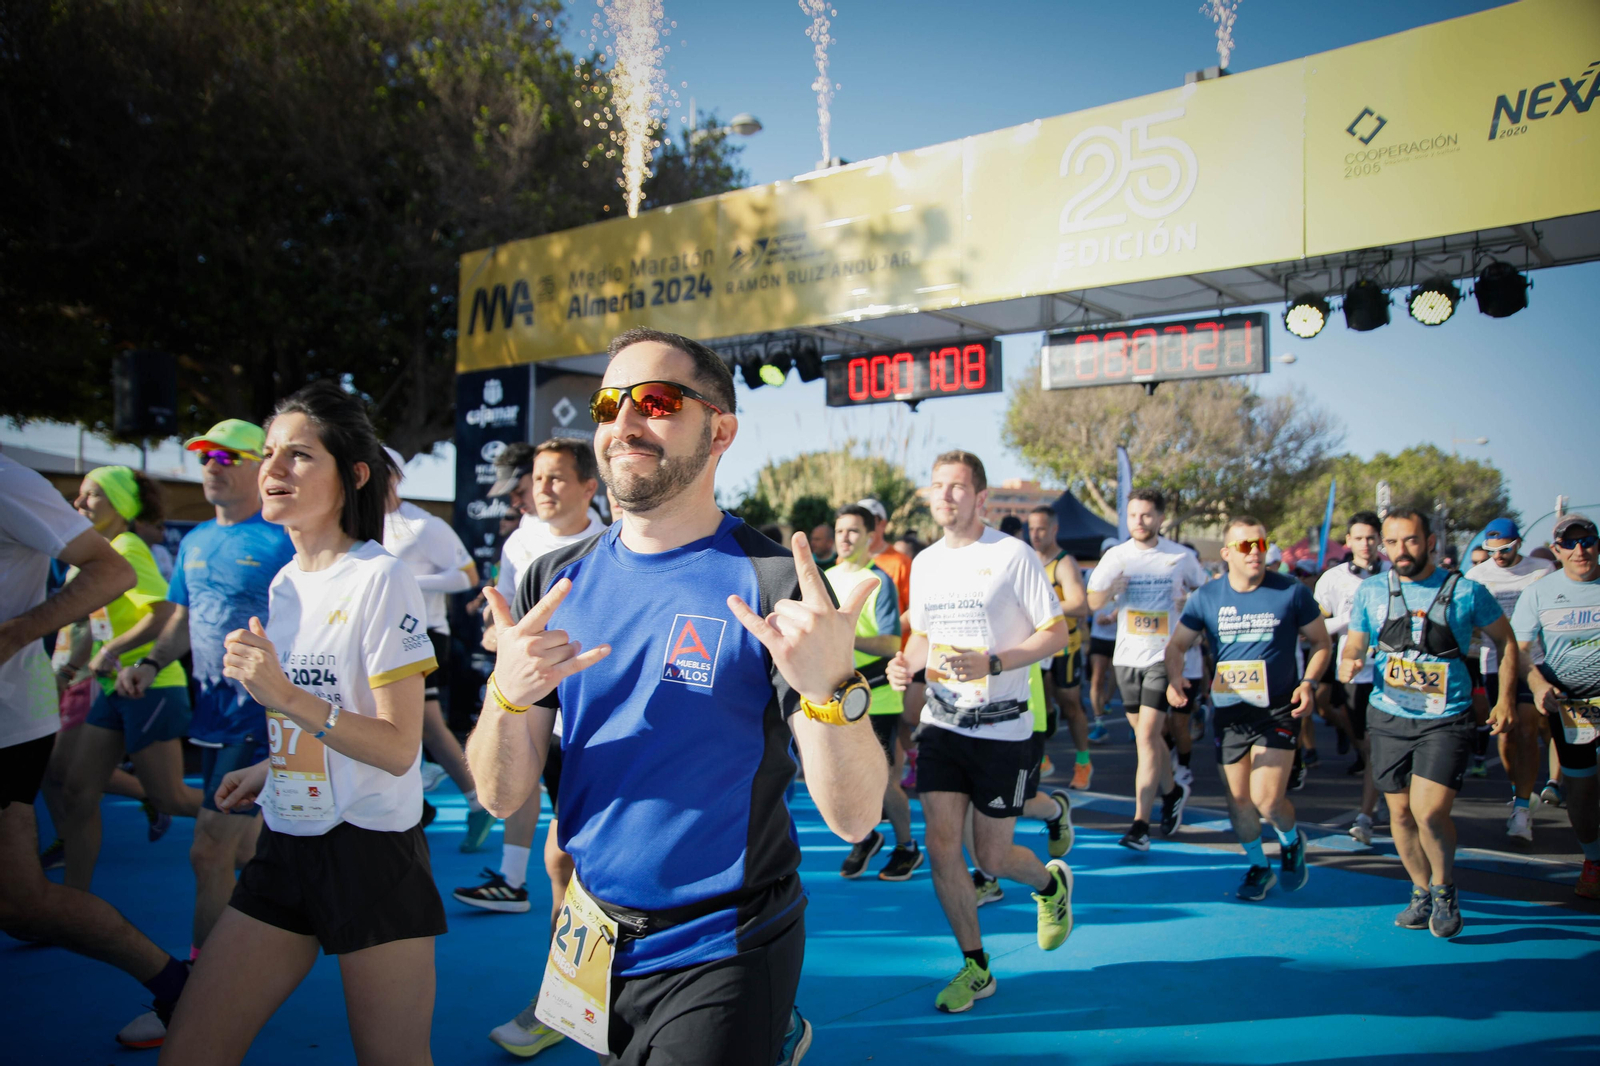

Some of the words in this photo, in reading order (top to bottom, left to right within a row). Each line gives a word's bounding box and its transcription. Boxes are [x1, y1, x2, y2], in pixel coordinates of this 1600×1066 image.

[1499, 125, 1528, 139] 2020
[1344, 133, 1458, 165] COOPERACIÓN
[1059, 107, 1198, 235] 25
[1344, 160, 1381, 178] 2005
[1057, 220, 1197, 271] EDICIÓN
[568, 264, 624, 290] Medio
[630, 248, 714, 278] Maratón
[726, 271, 781, 295] RAMÓN
[787, 265, 825, 285] RUIZ
[567, 282, 645, 320] Almería
[651, 272, 713, 306] 2024
[957, 598, 984, 609] 2024
[1134, 616, 1159, 629] 891
[291, 667, 337, 686] 2024
[664, 667, 708, 682] AVALOS
[676, 659, 711, 671] MUEBLES
[1219, 670, 1260, 684] 1924
[267, 718, 303, 755] 97
[556, 905, 588, 967] 21
